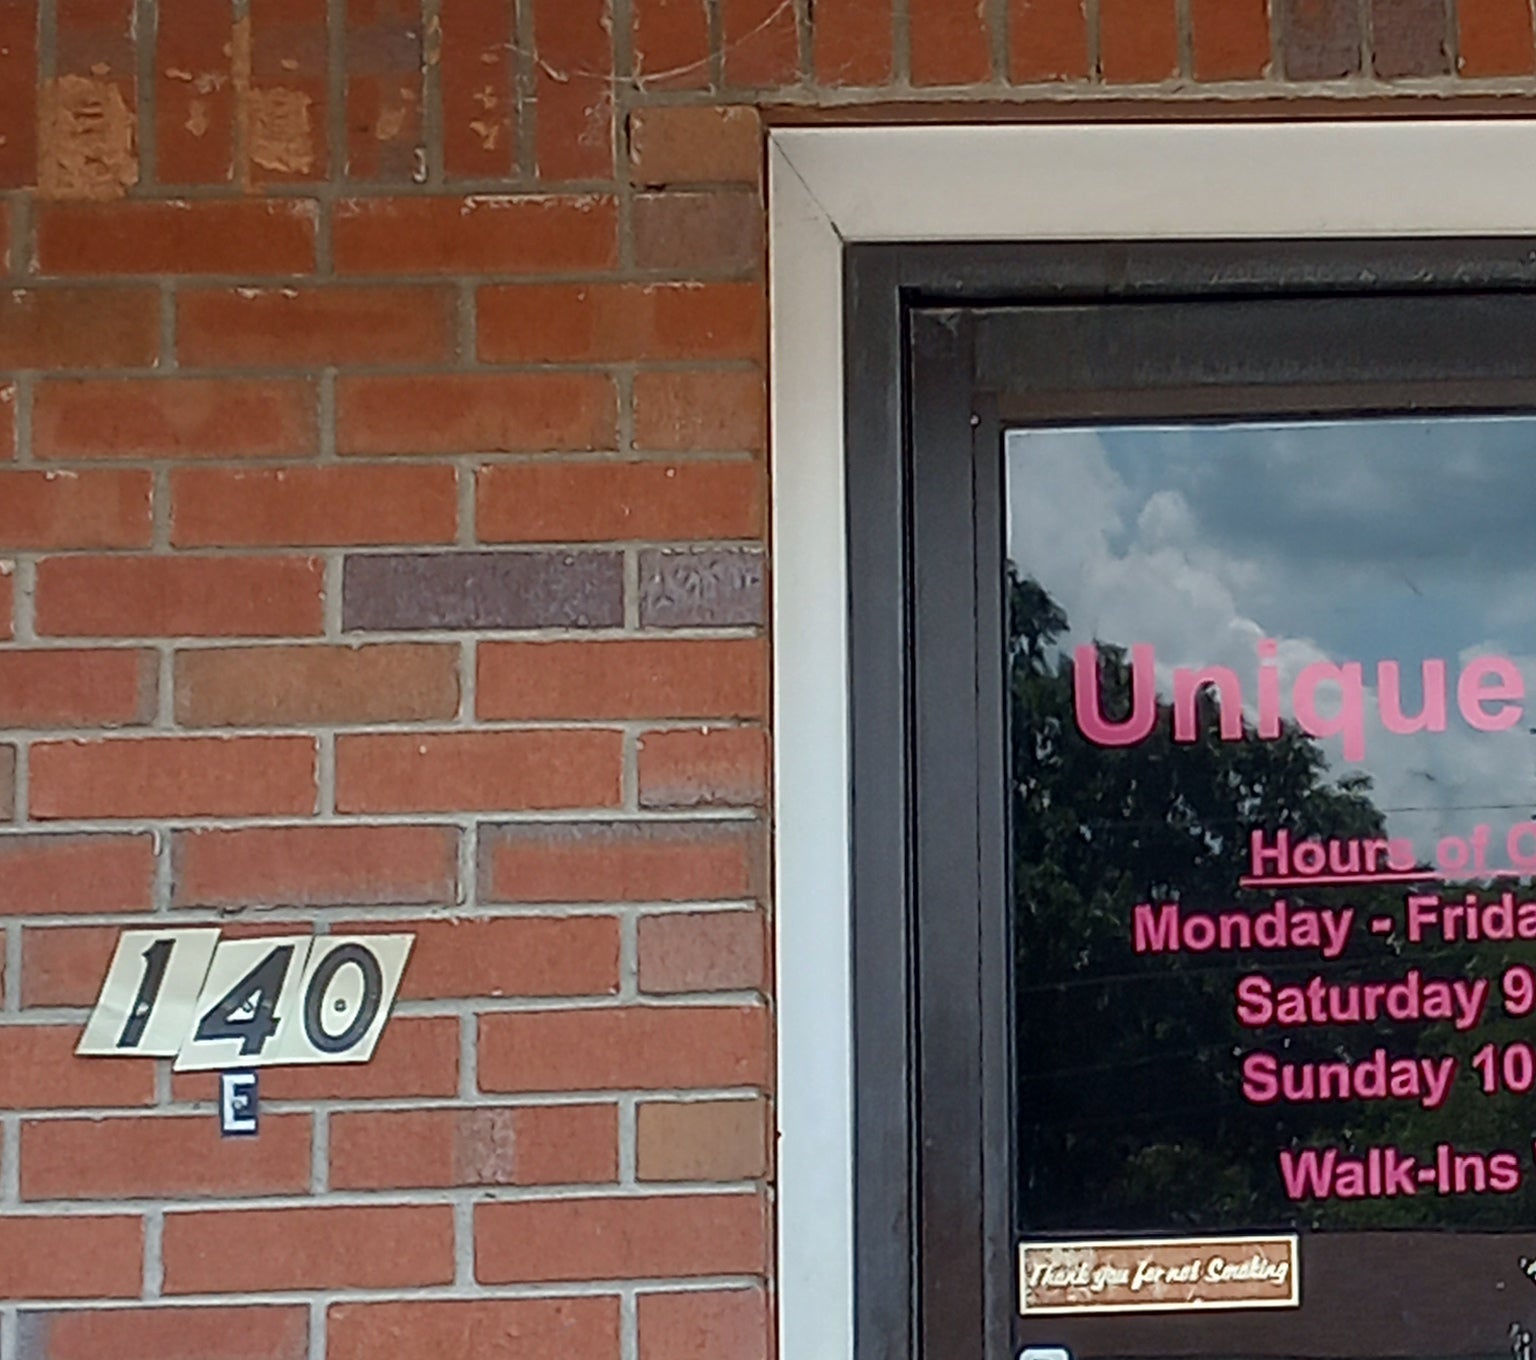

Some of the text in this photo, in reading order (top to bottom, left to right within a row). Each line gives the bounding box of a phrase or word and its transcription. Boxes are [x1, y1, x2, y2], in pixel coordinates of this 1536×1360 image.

[1073, 639, 1525, 762] Unique
[1251, 828, 1417, 877] Hours
[1436, 823, 1490, 875] of
[1134, 900, 1354, 958] Monday
[116, 939, 384, 1056] 140
[1236, 970, 1487, 1030] Saturday
[1502, 966, 1535, 1015] 9
[222, 1073, 257, 1131] E
[1242, 1048, 1454, 1107] Sunday
[1472, 1043, 1534, 1092] 10
[1279, 1144, 1520, 1199] Walk-Ins
[1029, 1259, 1089, 1288] Thank
[1089, 1262, 1130, 1293] you
[1131, 1257, 1164, 1291] for
[1204, 1254, 1289, 1285] Smoking
